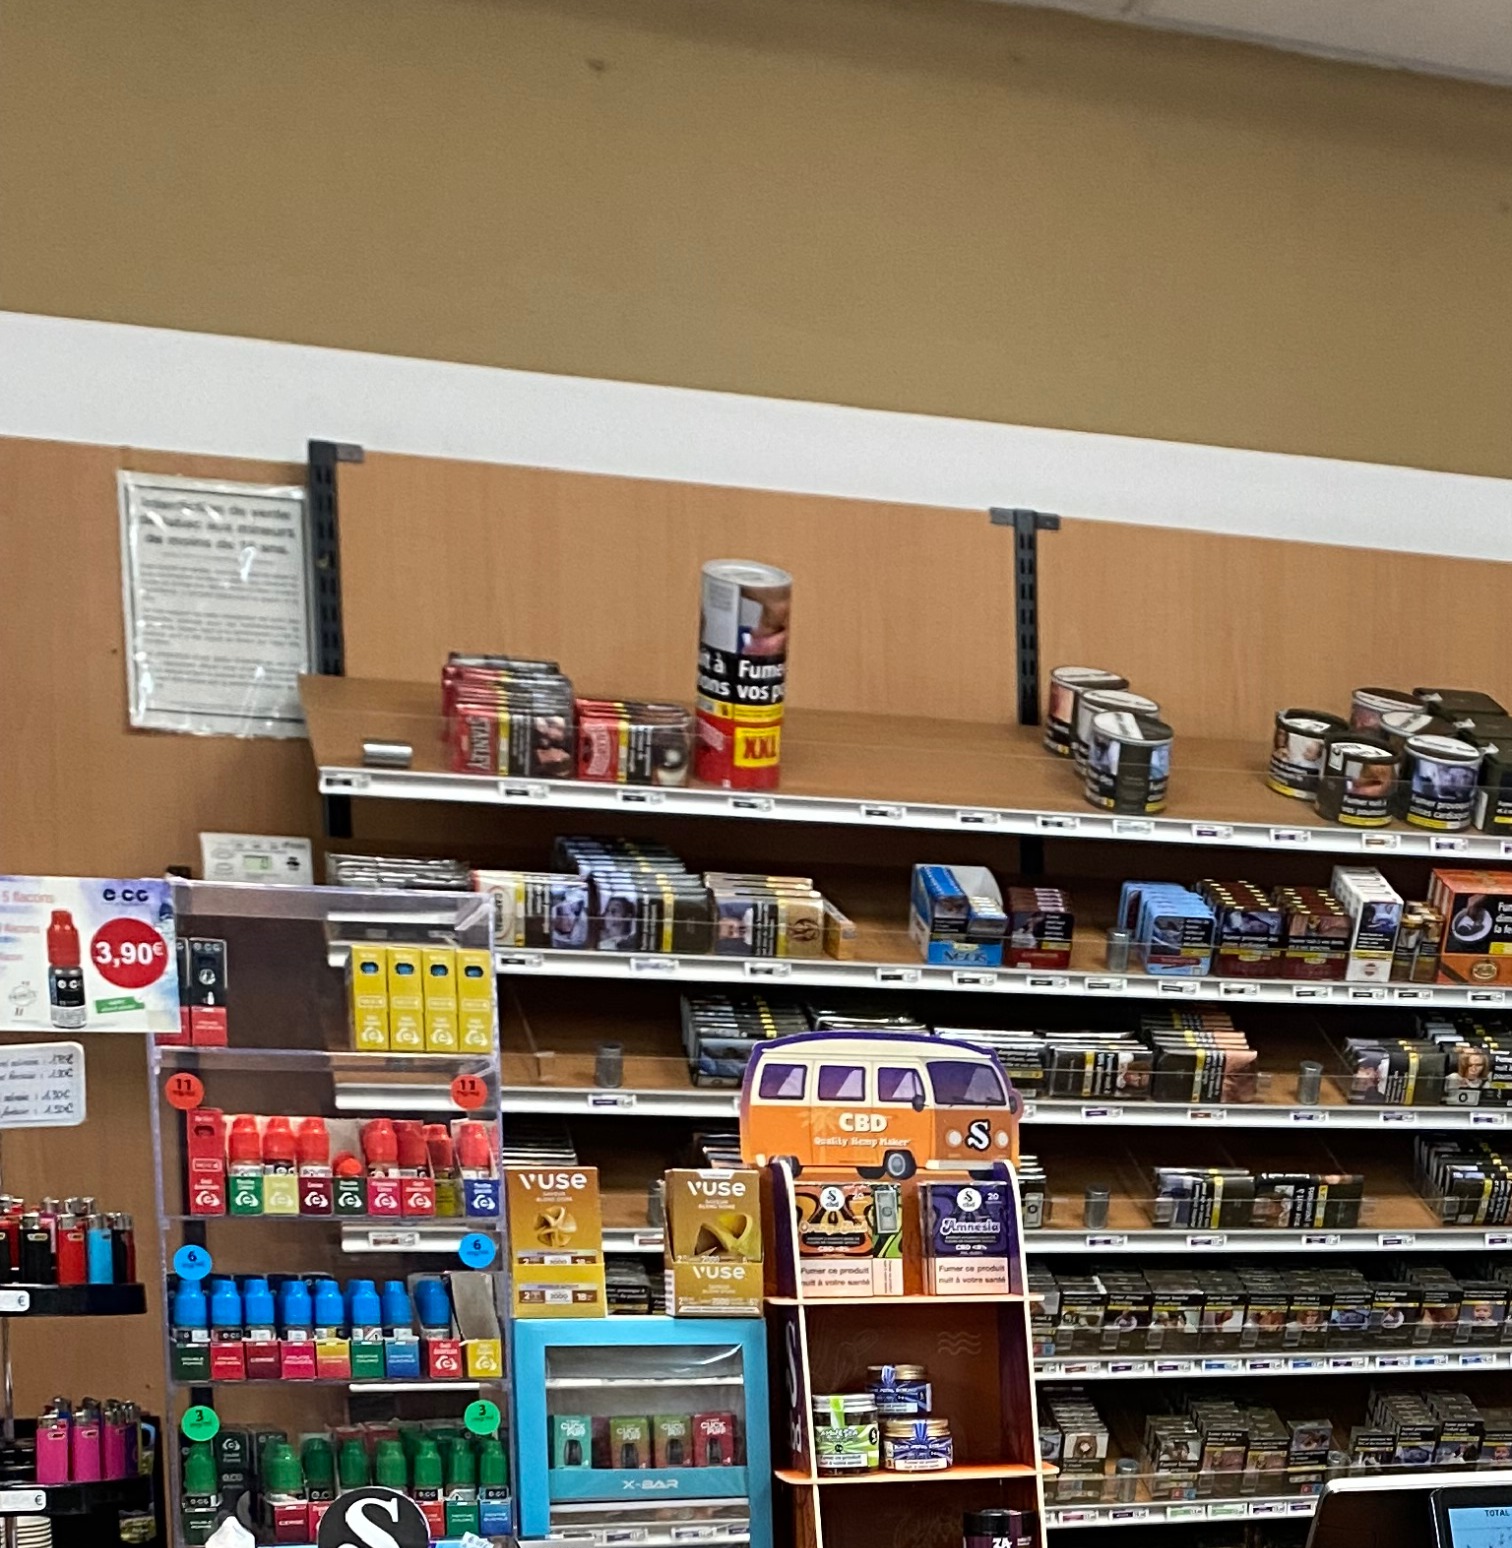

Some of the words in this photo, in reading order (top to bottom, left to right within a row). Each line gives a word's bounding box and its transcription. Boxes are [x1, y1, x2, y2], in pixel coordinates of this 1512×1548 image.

[737, 684, 768, 701] vos
[95, 941, 164, 968] 3,90€
[175, 1078, 192, 1092] 11
[460, 1079, 476, 1091] 11
[839, 1113, 888, 1132] CBD
[940, 1218, 1000, 1234] Amnesia
[840, 1267, 869, 1276] produit
[939, 1265, 962, 1273] Fumer
[977, 1265, 1005, 1274] produit
[847, 1279, 870, 1287] santé
[983, 1276, 1006, 1284] santé
[623, 1479, 679, 1490] X-BAR
[1485, 1509, 1510, 1517] TOTAL
